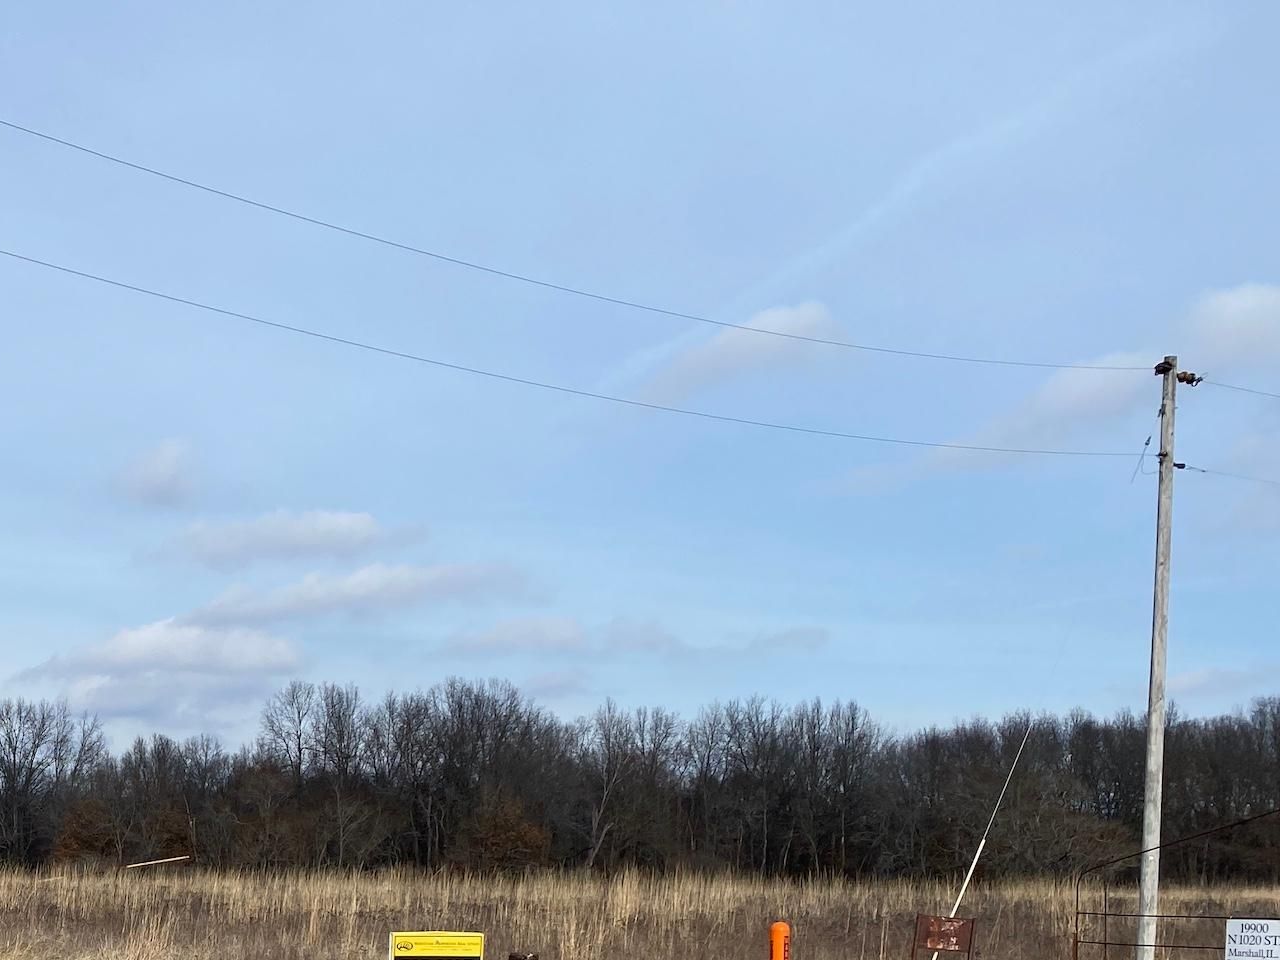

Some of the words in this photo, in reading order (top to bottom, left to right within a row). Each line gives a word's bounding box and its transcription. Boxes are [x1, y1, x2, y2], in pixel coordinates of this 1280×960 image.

[1240, 923, 1269, 933] 19900
[1228, 934, 1237, 945] N
[1239, 934, 1262, 945] 1020
